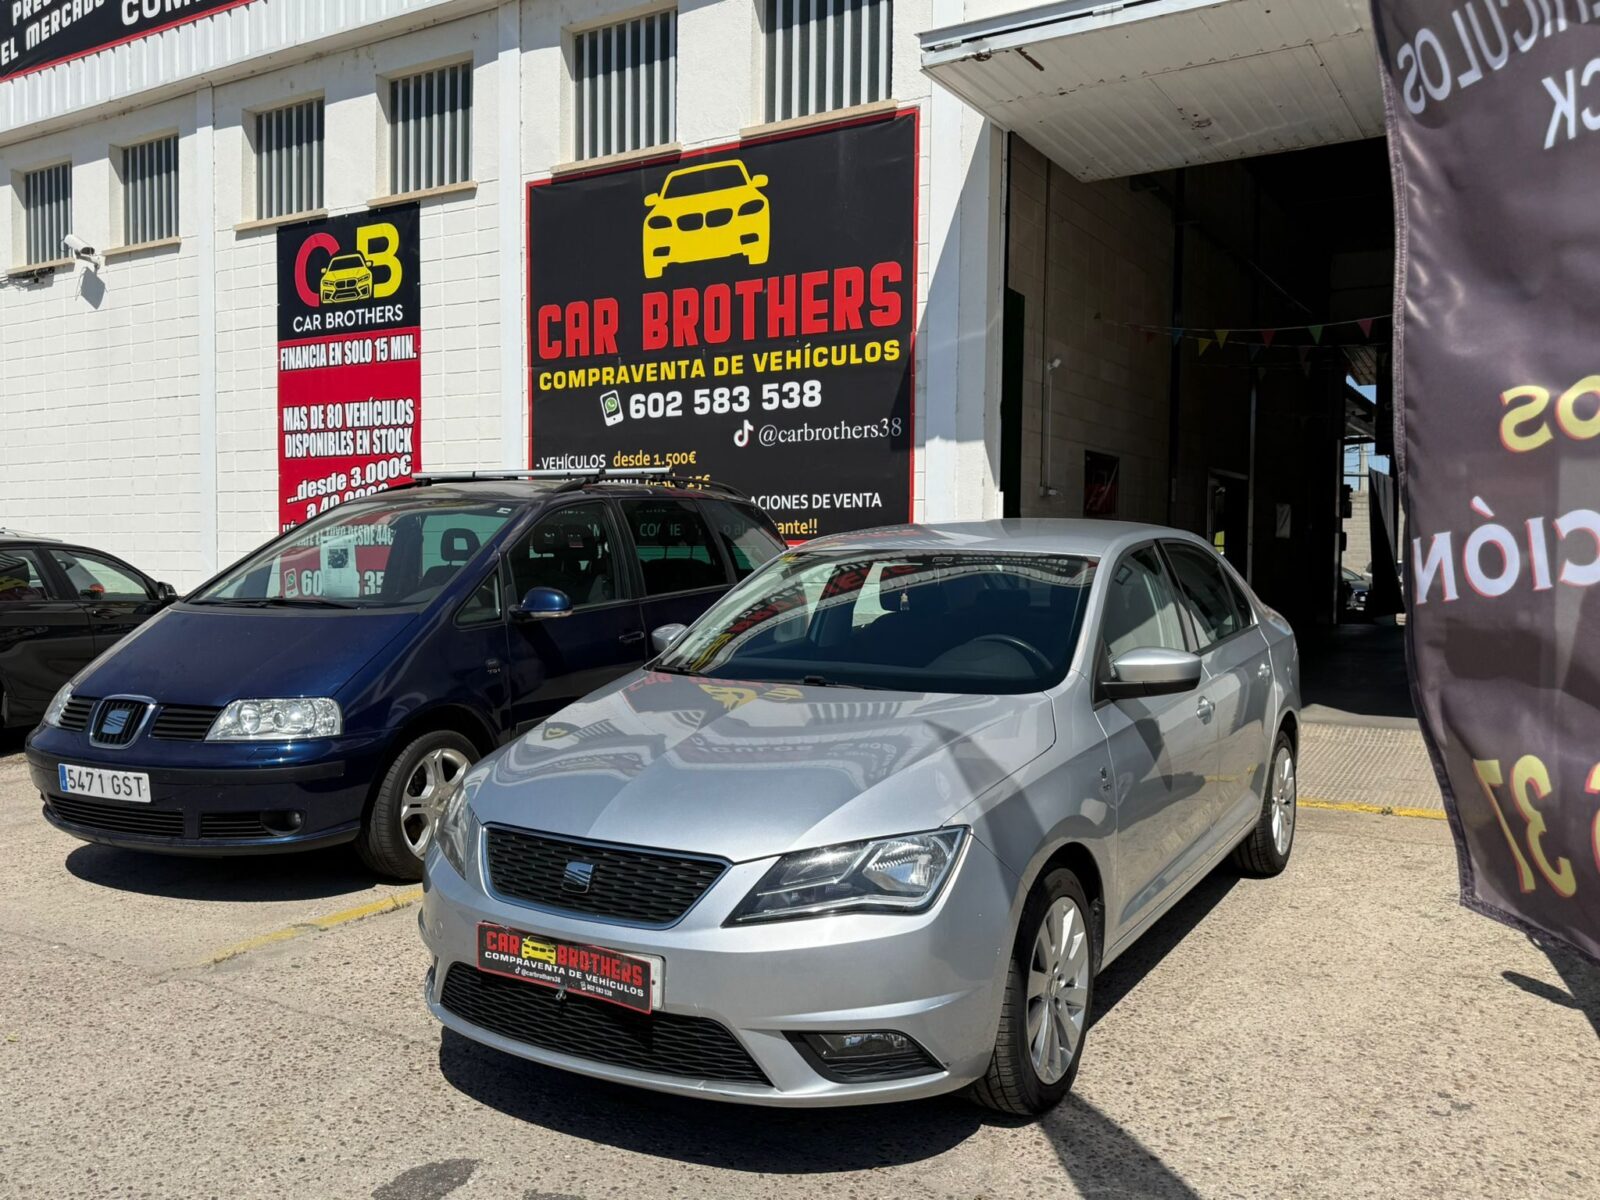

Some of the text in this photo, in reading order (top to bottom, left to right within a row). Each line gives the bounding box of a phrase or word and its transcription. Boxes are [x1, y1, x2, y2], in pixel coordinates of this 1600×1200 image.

[0, 37, 19, 66] EL
[293, 304, 404, 333] CAR BROTHERS
[538, 261, 903, 360] CAR BROTHERS
[280, 334, 417, 371] FINANCIA EN SOLO 15 MIN.
[539, 338, 901, 391] COMPRAVENTA DE VEHÍCULOS
[283, 397, 415, 431] MAS DE 80 VEHÍCULOS
[629, 379, 823, 420] 602 583 538
[284, 427, 413, 458] DISPONIBLES EN STOCK
[758, 416, 903, 448] @carbrothers38
[350, 454, 412, 487] 3.000€
[613, 450, 651, 467] desde
[653, 450, 697, 469] 1.500€
[812, 494, 831, 509] DE
[832, 492, 883, 509] VENTA
[67, 769, 142, 797] 5471 GST
[485, 951, 645, 997] COMPRAVENTA DE VEHÍCULOS
[486, 931, 643, 987] CAR BROTHERS
